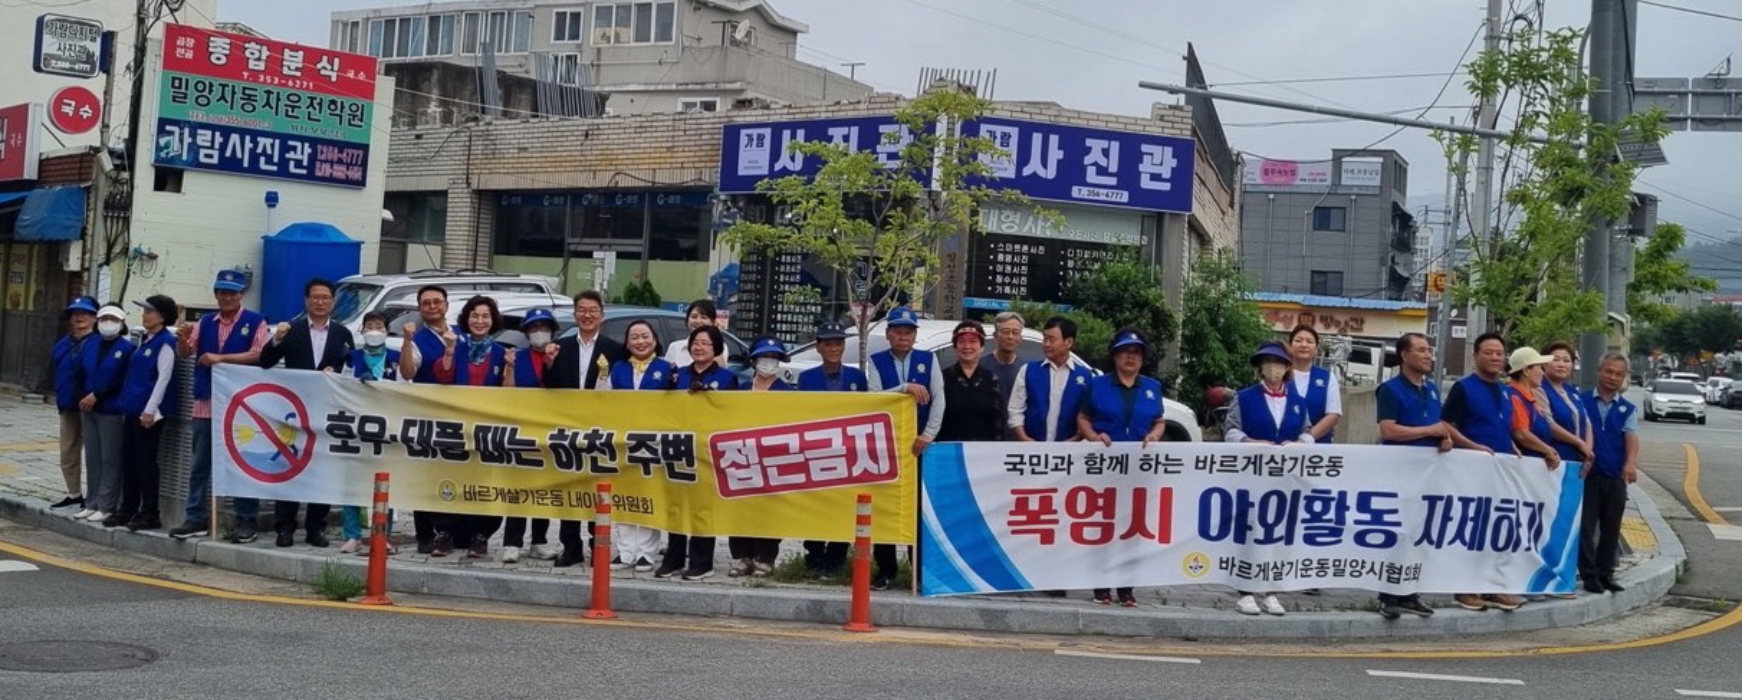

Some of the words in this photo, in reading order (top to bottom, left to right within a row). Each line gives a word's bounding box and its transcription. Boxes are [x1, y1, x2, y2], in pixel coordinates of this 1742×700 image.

[57, 42, 88, 61] 사진관
[208, 35, 341, 83] 종합분식
[61, 99, 93, 119] 국수
[170, 75, 365, 129] 밀양자동차운전학원
[164, 124, 314, 175] 가람사진관
[744, 133, 766, 149] 가람
[986, 129, 1012, 149] 가람
[1022, 132, 1178, 192] 사진관
[325, 410, 471, 462] 호우·태풍
[474, 424, 545, 470] 때는
[548, 428, 620, 474] 하천
[626, 433, 697, 482] 주변
[716, 421, 891, 491] 접근금지
[1003, 453, 1074, 476] 국민과
[1083, 452, 1130, 476] 함께
[1138, 453, 1185, 475] 하는
[1194, 453, 1345, 478] 바르게살기운동
[462, 483, 564, 508] 바르게살기운동
[611, 493, 655, 515] 위원회
[1006, 485, 1174, 546] 폭염시
[1197, 486, 1403, 550] 야외활동
[1413, 494, 1545, 553] 자제하기
[1218, 556, 1422, 585] 바르게살기운동밀양시협의회
